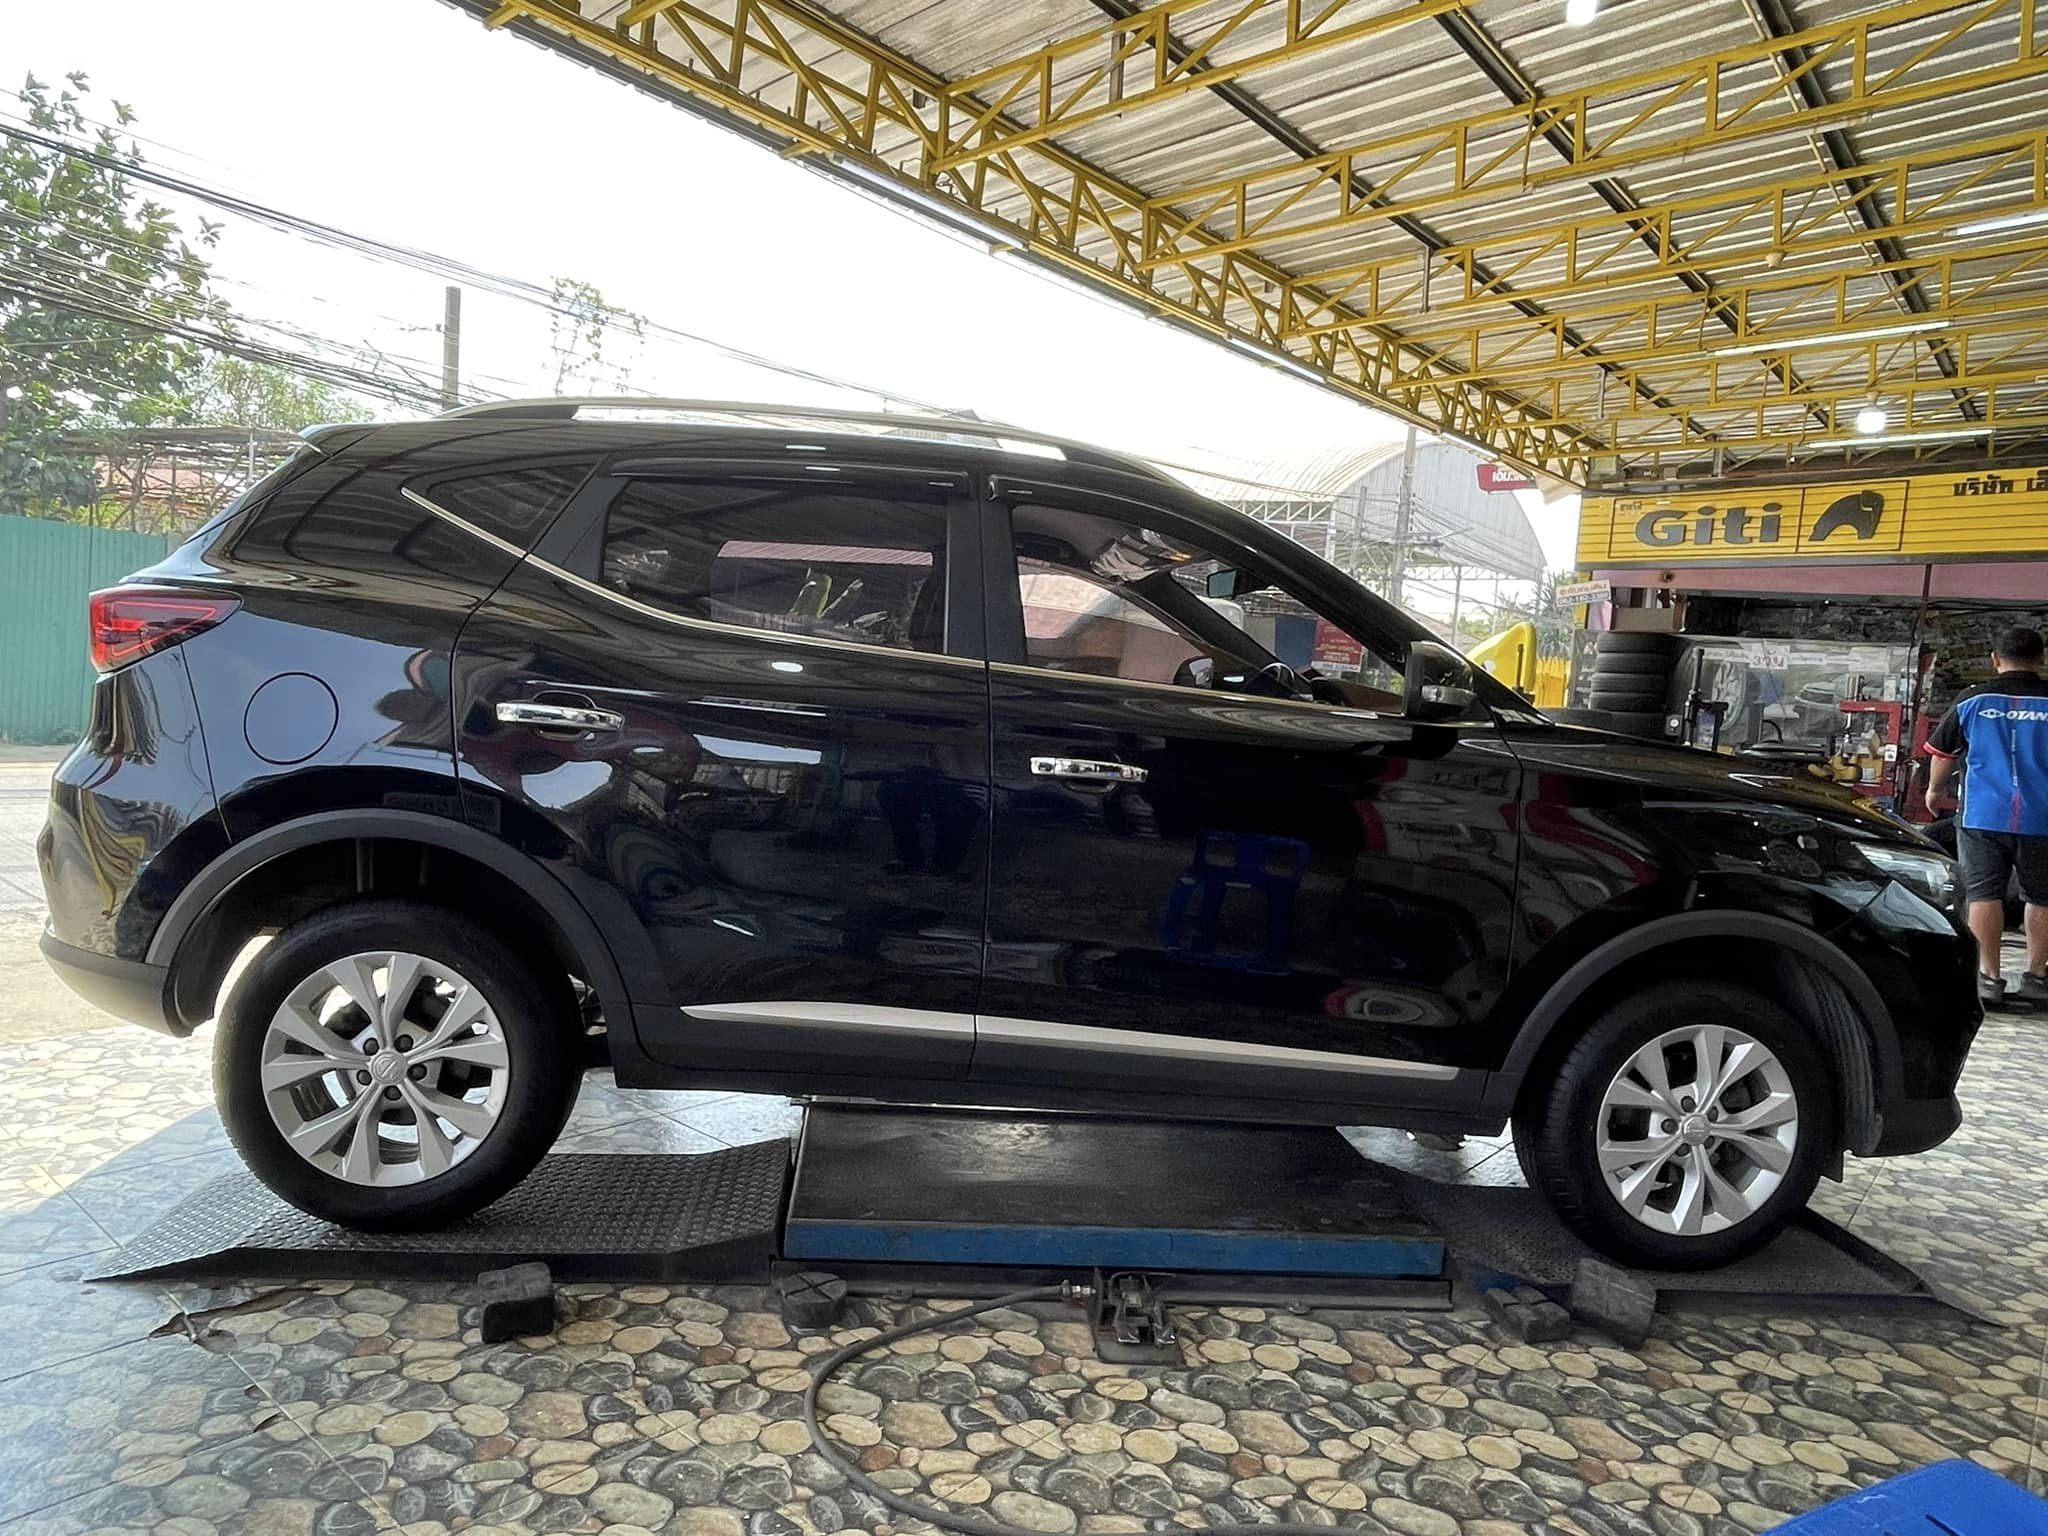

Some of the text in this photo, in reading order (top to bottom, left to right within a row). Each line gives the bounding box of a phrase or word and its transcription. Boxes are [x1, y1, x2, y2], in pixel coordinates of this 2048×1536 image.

[1953, 474, 2014, 497] บริษัท
[1635, 502, 1783, 547] Giti
[2006, 710, 2048, 721] OTAN
